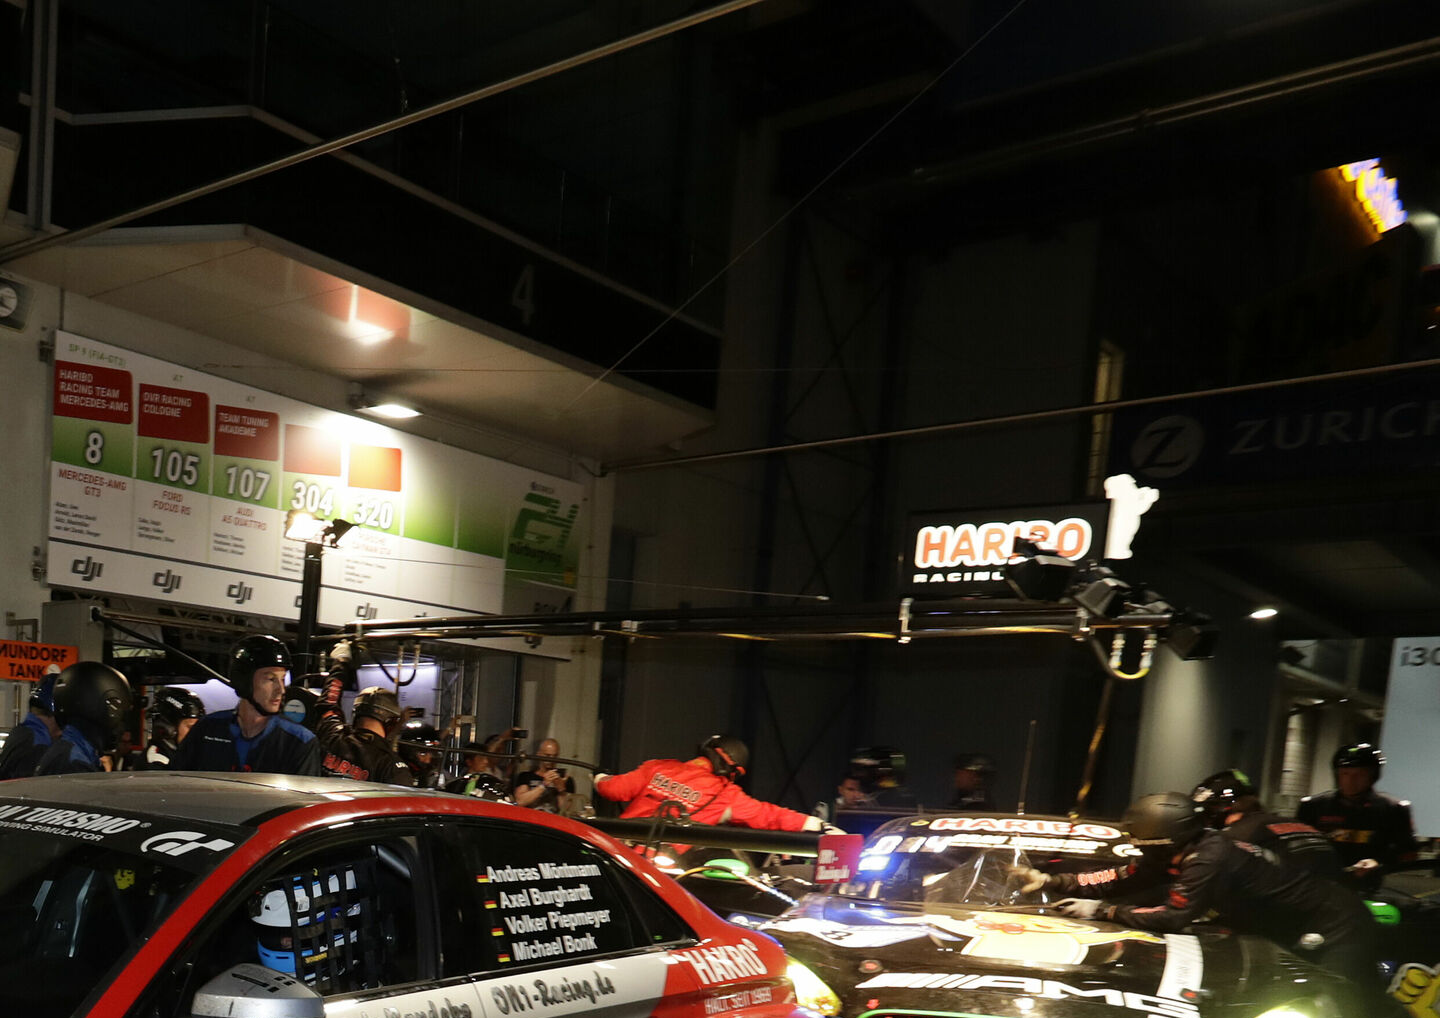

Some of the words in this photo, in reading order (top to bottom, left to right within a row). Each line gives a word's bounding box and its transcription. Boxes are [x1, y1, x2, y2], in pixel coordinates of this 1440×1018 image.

[60, 369, 93, 382] HARIBO
[60, 382, 93, 395] RACING
[96, 386, 120, 398] TEAM
[60, 395, 129, 412] MERCEDES-AMG
[219, 412, 239, 423] TEAM
[85, 431, 103, 464] 8
[152, 448, 200, 485] 105
[59, 469, 126, 491] MERCEDES-AMG
[226, 465, 271, 500] 107
[291, 480, 335, 517] 304
[353, 499, 393, 530] 320
[650, 772, 702, 803] HARIBO
[14, 806, 142, 834] TURISMO
[931, 818, 1121, 839] HARIBO
[31, 825, 104, 843] SIMULATOR
[486, 865, 541, 883] Andreas
[500, 890, 531, 909] Axel
[529, 884, 593, 907] Burghardt
[505, 915, 548, 934] Volker
[547, 910, 611, 931] Piepmeyer
[512, 937, 564, 961] Michael
[563, 933, 598, 953] Bonk
[683, 943, 768, 985] HAKRO
